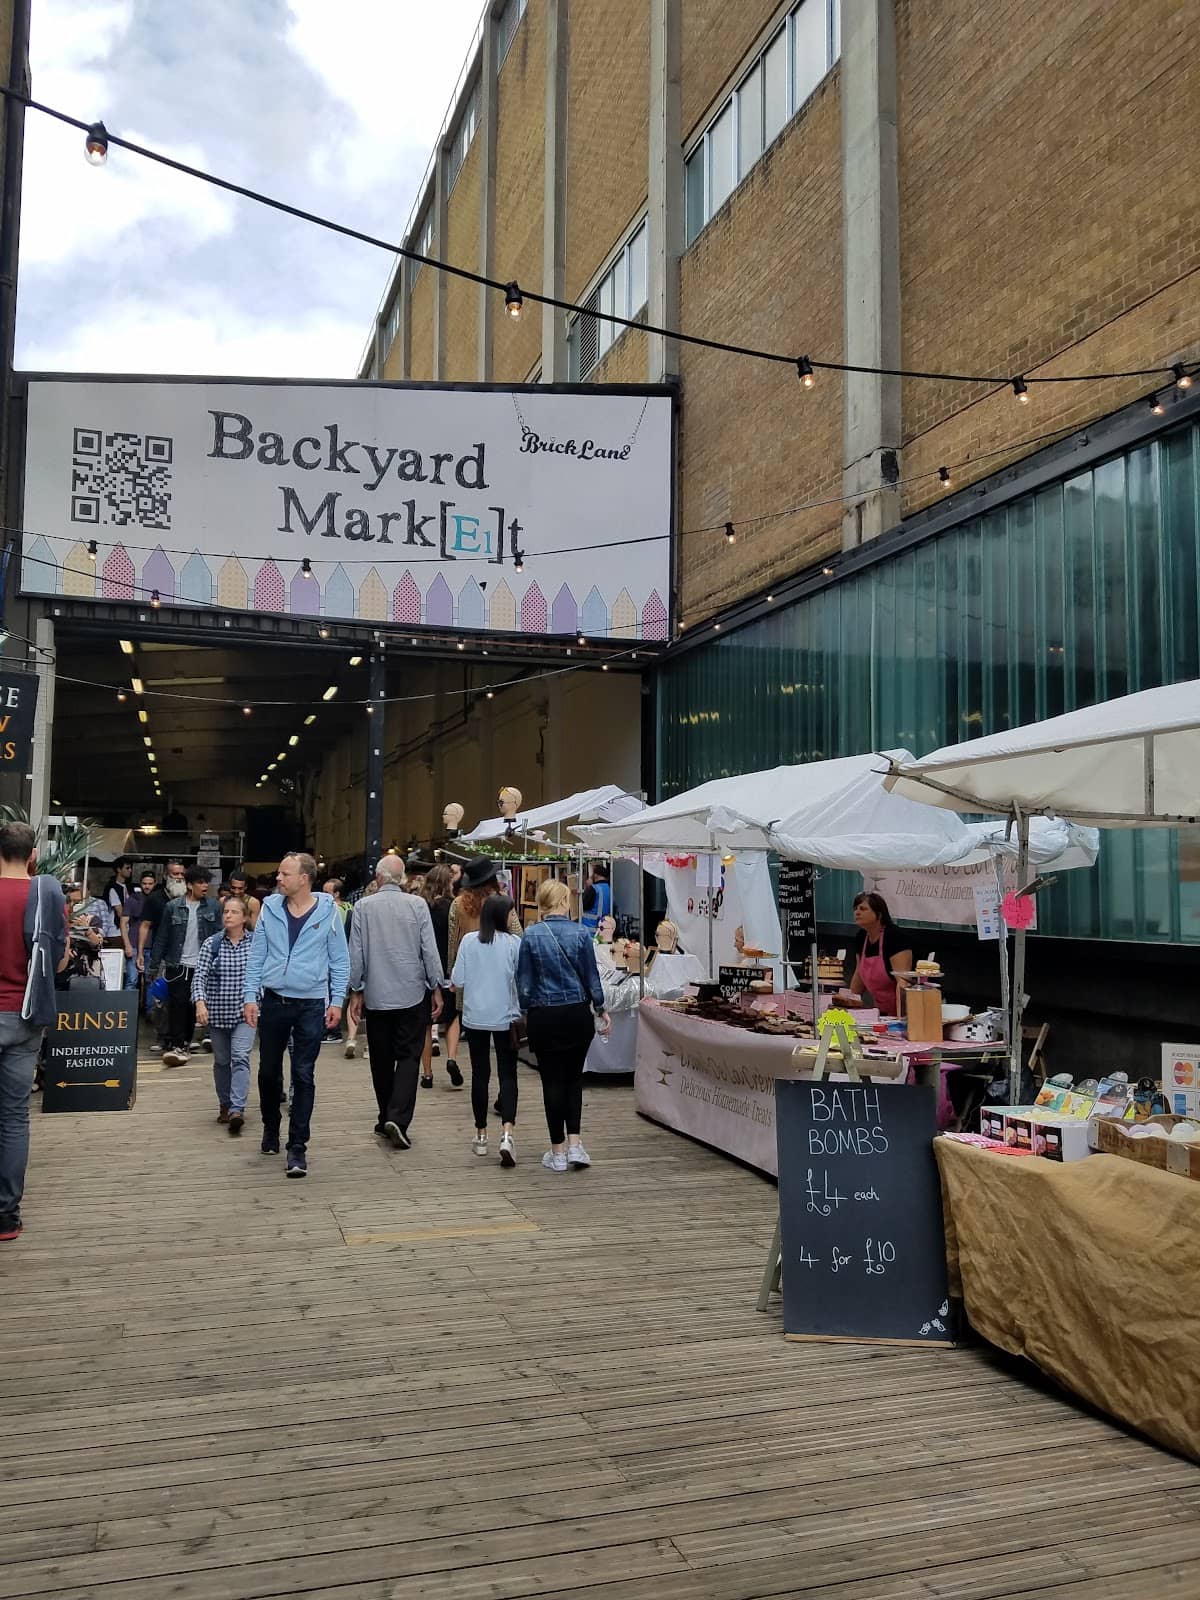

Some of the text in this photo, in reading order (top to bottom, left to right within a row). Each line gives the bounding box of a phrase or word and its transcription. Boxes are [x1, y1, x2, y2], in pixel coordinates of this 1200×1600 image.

[207, 409, 490, 491] Backyard
[520, 426, 631, 460] Brick Lane
[895, 879, 939, 898] Delicious
[941, 881, 974, 900] Homem
[720, 967, 763, 977] ALL ITEMS
[56, 1010, 129, 1031] RINSE
[51, 1045, 131, 1057] INDEPENDENT
[65, 1058, 115, 1068] FASHION
[679, 1075, 712, 1105] Delicious
[751, 1099, 773, 1129] Treats
[810, 1087, 882, 1124] BATH
[808, 1126, 890, 1155] BOMBS
[805, 1168, 880, 1217] £4 each
[799, 1238, 896, 1275] 4 for £10
